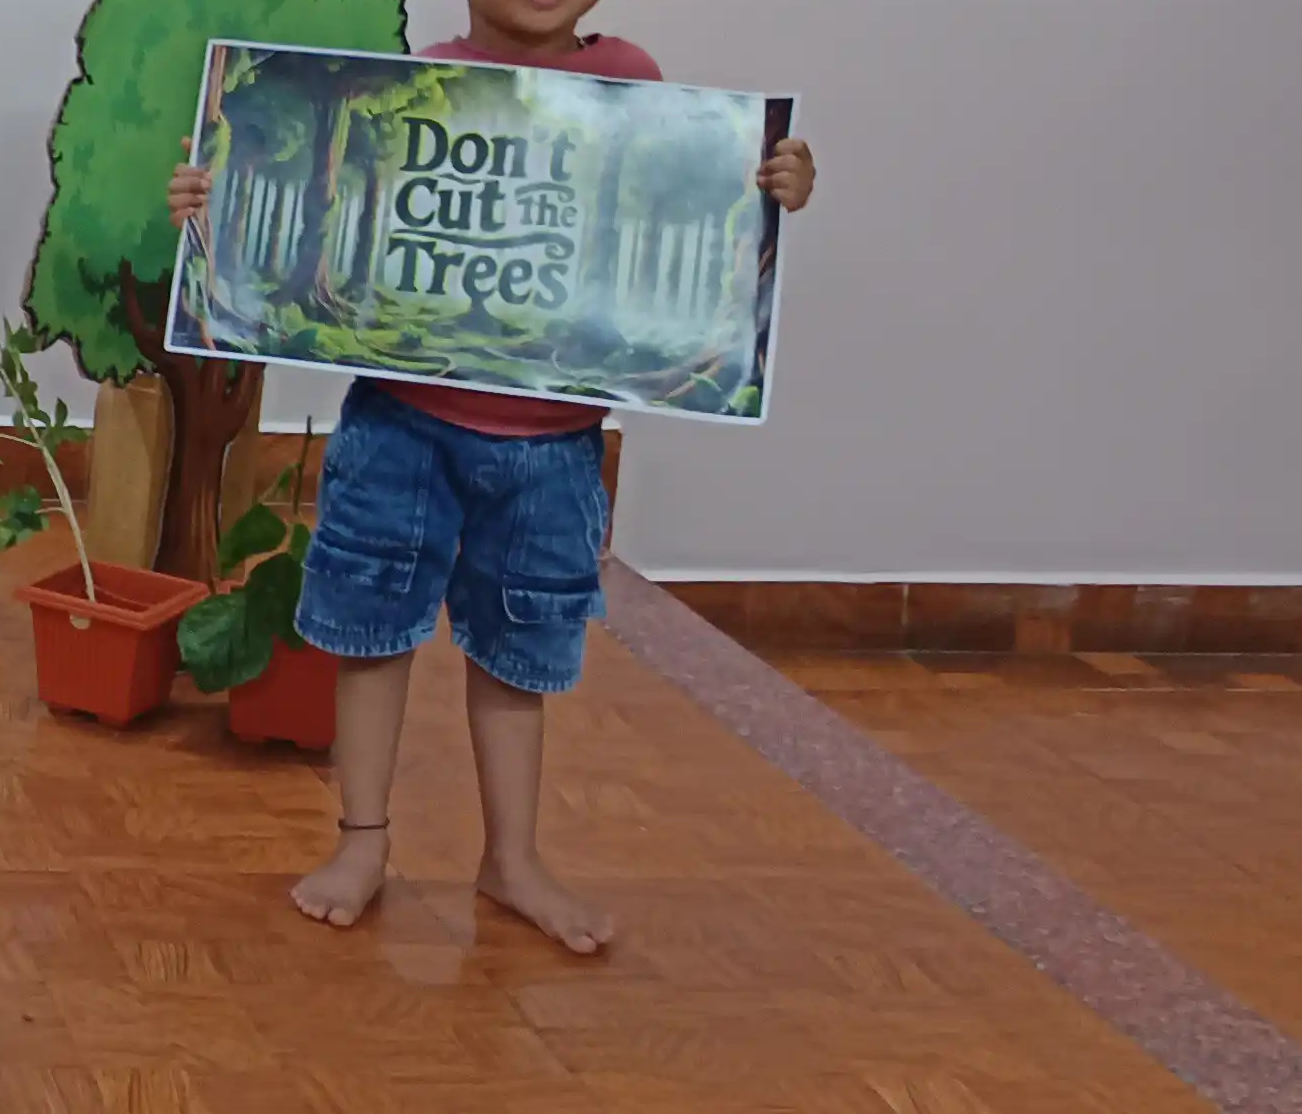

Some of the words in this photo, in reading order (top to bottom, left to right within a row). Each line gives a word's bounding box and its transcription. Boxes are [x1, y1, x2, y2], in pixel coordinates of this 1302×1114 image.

[399, 116, 576, 182] Don't
[395, 177, 506, 233] Cut
[385, 236, 570, 311] Trees
